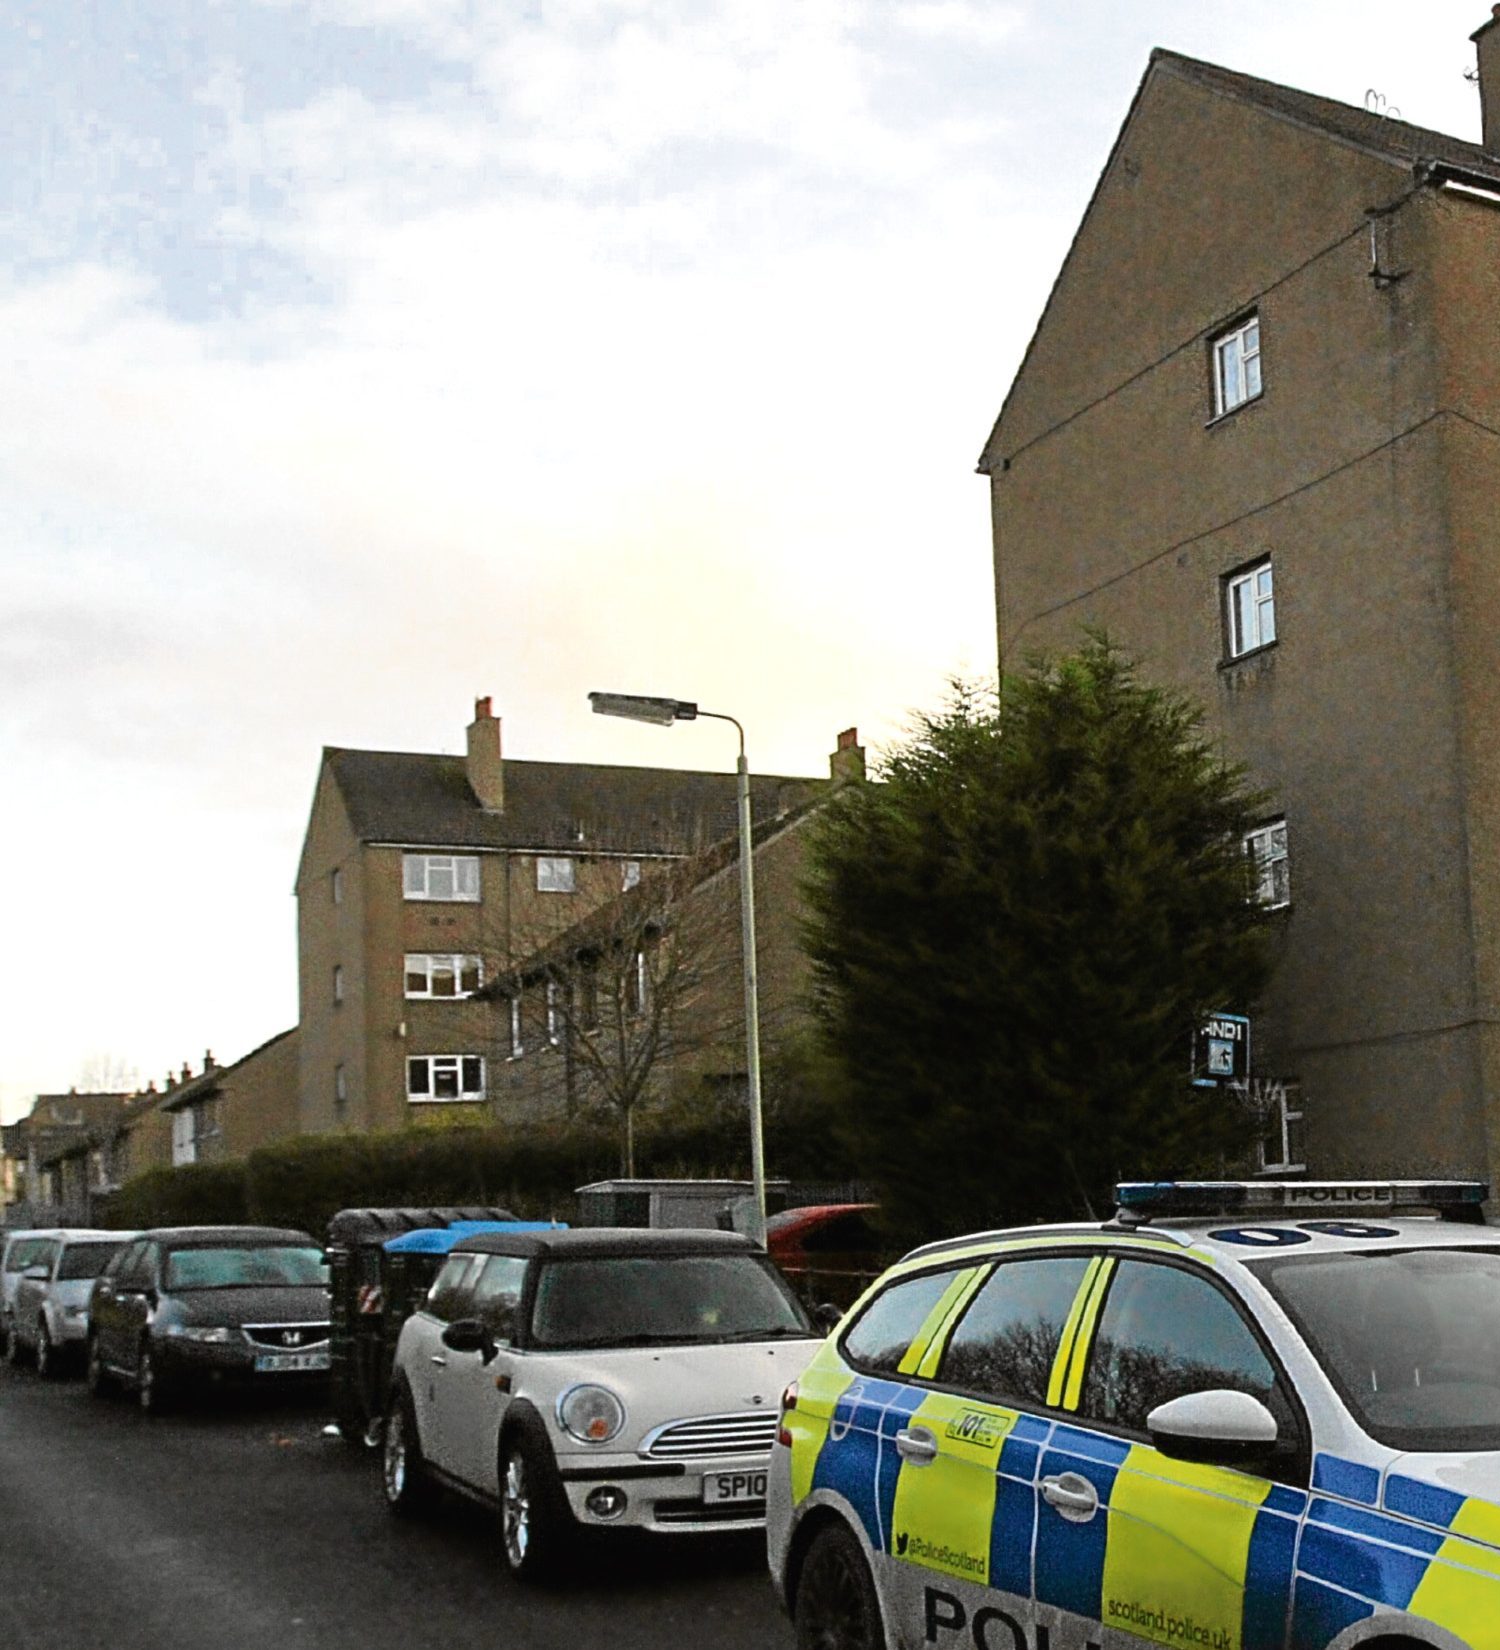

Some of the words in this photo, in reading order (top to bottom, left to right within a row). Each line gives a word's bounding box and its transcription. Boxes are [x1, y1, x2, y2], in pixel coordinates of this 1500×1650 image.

[1291, 1186, 1390, 1201] POLICE
[956, 1414, 987, 1440] 101
[717, 1474, 768, 1498] SP10
